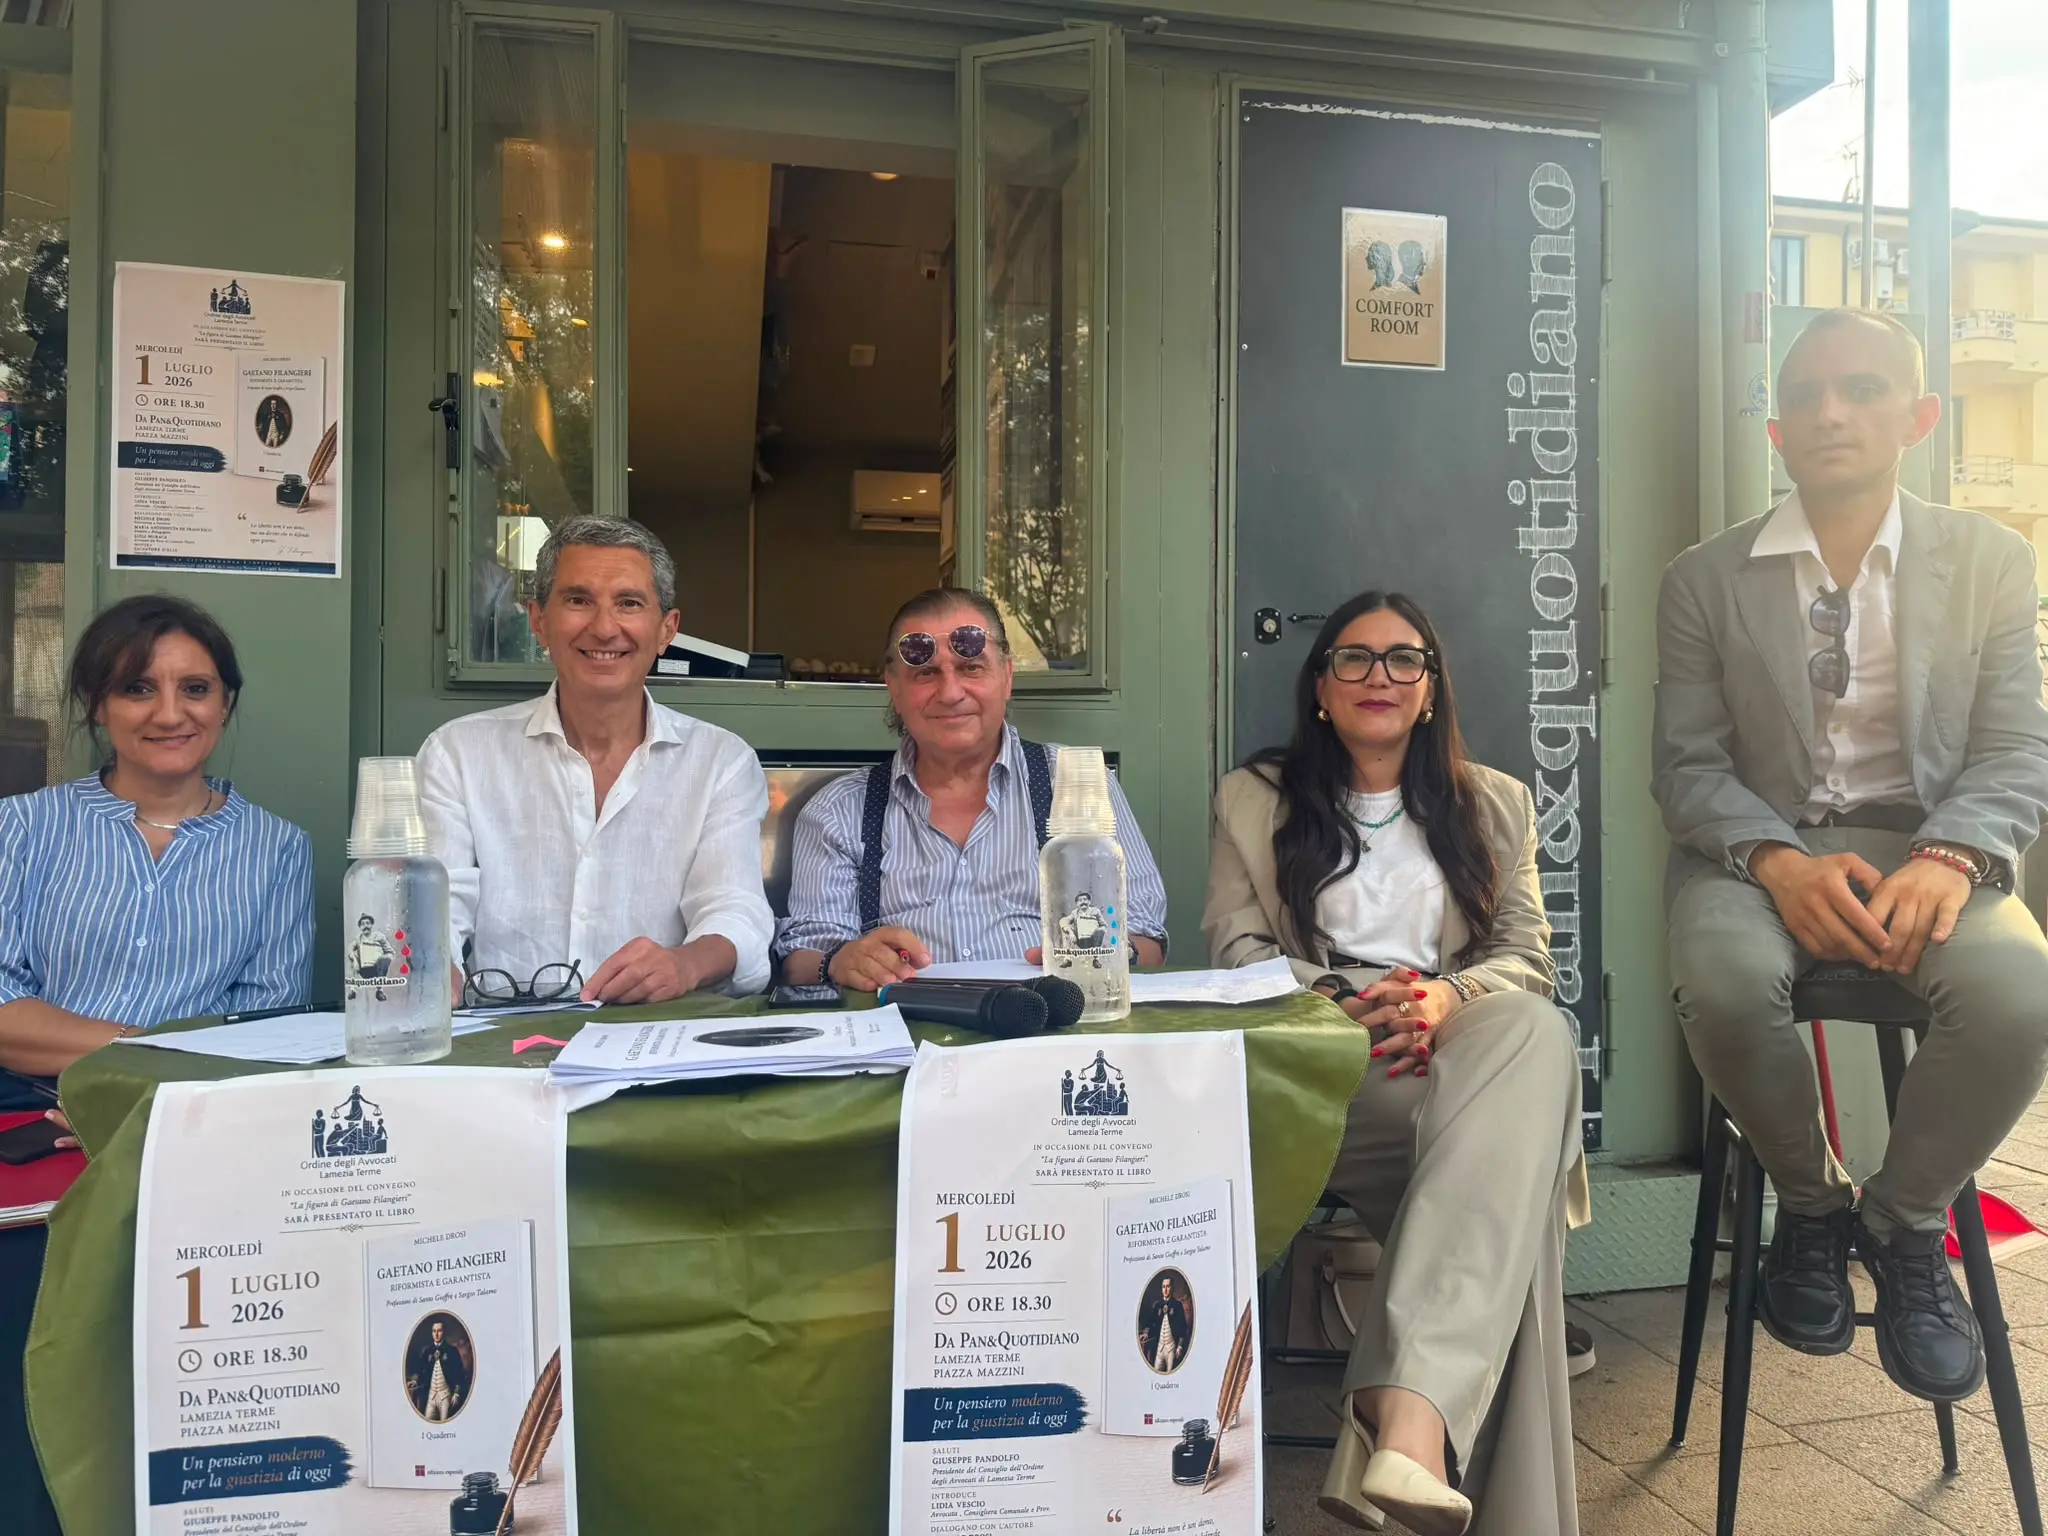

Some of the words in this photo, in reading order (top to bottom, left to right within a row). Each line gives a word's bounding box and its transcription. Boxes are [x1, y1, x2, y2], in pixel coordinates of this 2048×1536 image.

[1356, 298, 1434, 318] COMFORT
[1370, 318, 1419, 335] ROOM
[136, 344, 182, 354] MERCOLEDÌ
[136, 355, 153, 385] 1
[165, 363, 212, 375] LUGLIO
[165, 376, 192, 387] 2026
[154, 398, 176, 406] ORE
[181, 400, 204, 408] 18.30
[200, 460, 215, 469] oggi
[1054, 948, 1114, 956] pan&quotidiano
[1051, 1118, 1079, 1126] Ordine
[1082, 1118, 1100, 1127] degli
[1103, 1118, 1136, 1126] Avvocati
[301, 1161, 331, 1169] Ordine
[334, 1159, 355, 1168] degli
[358, 1155, 396, 1165] Avvocati
[1055, 1156, 1075, 1165] figura
[320, 1170, 353, 1178] Lamezia
[356, 1168, 381, 1176] Terme
[1036, 1168, 1058, 1176] SARÀ
[294, 1187, 344, 1196] OCCASIONE
[367, 1181, 416, 1190] CONVEGNO
[306, 1200, 328, 1210] figura
[936, 1190, 1015, 1205] MERCOLEDÌ
[1149, 1194, 1173, 1204] MICHELE
[285, 1214, 309, 1224] SARÀ
[314, 1211, 372, 1222] PRESENTATO
[388, 1208, 415, 1216] LIBRO
[1116, 1220, 1164, 1236] GAETANO
[1167, 1208, 1217, 1229] FILANGIERI
[414, 1235, 444, 1245] MICHELE
[446, 1231, 466, 1240] DROSI
[936, 1212, 965, 1272] 1
[986, 1224, 1065, 1241] LUGLIO
[1128, 1237, 1165, 1248] RIFORMISTA
[1172, 1230, 1207, 1242] GARANTISTA
[176, 1240, 262, 1260] MERCOLEDÌ
[377, 1262, 432, 1279] GAETANO
[437, 1250, 506, 1271] FILANGIERI
[986, 1250, 1032, 1269] 2026
[390, 1280, 434, 1292] RIFORMISTA
[442, 1272, 491, 1285] GARANTISTA
[176, 1266, 209, 1330] 1
[231, 1271, 320, 1294] LUGLIO
[968, 1297, 1004, 1312] ORE
[1012, 1296, 1051, 1311] 18.30
[232, 1300, 284, 1323] 2026
[214, 1350, 255, 1367] ORE
[264, 1345, 308, 1363] 18.30
[934, 1355, 981, 1364] LAMEZIA
[985, 1353, 1020, 1363] TERME
[934, 1369, 973, 1378] PIAZZA
[977, 1367, 1024, 1377] MAZZINI
[934, 1398, 952, 1410] Un
[956, 1396, 1006, 1413] pensiero
[1012, 1393, 1062, 1408] moderno
[180, 1411, 232, 1423] LAMEZIA
[236, 1406, 275, 1418] TERME
[932, 1419, 953, 1433] per
[957, 1415, 968, 1429] la
[972, 1414, 1024, 1432] giustizia
[1028, 1412, 1039, 1425] di
[1044, 1411, 1068, 1428] oggi
[181, 1427, 223, 1437] PIAZZA
[228, 1420, 280, 1433] MAZZINI
[426, 1432, 456, 1440] Quaderni
[182, 1456, 203, 1470] Un
[208, 1452, 262, 1472] pensiero
[268, 1447, 325, 1462] moderno
[932, 1456, 972, 1465] GIUSEPPE
[976, 1454, 1020, 1463] PANDOLFO
[182, 1478, 205, 1494] per
[209, 1474, 221, 1487] la
[225, 1469, 283, 1490] giustizia
[288, 1466, 300, 1480] di
[305, 1465, 331, 1482] oggi
[184, 1515, 228, 1526] GIUSEPPE
[231, 1511, 280, 1522] PANDOLFO
[931, 1524, 977, 1533] DIALOGANO
[1129, 1527, 1139, 1536] La
[1142, 1525, 1165, 1535] libertà
